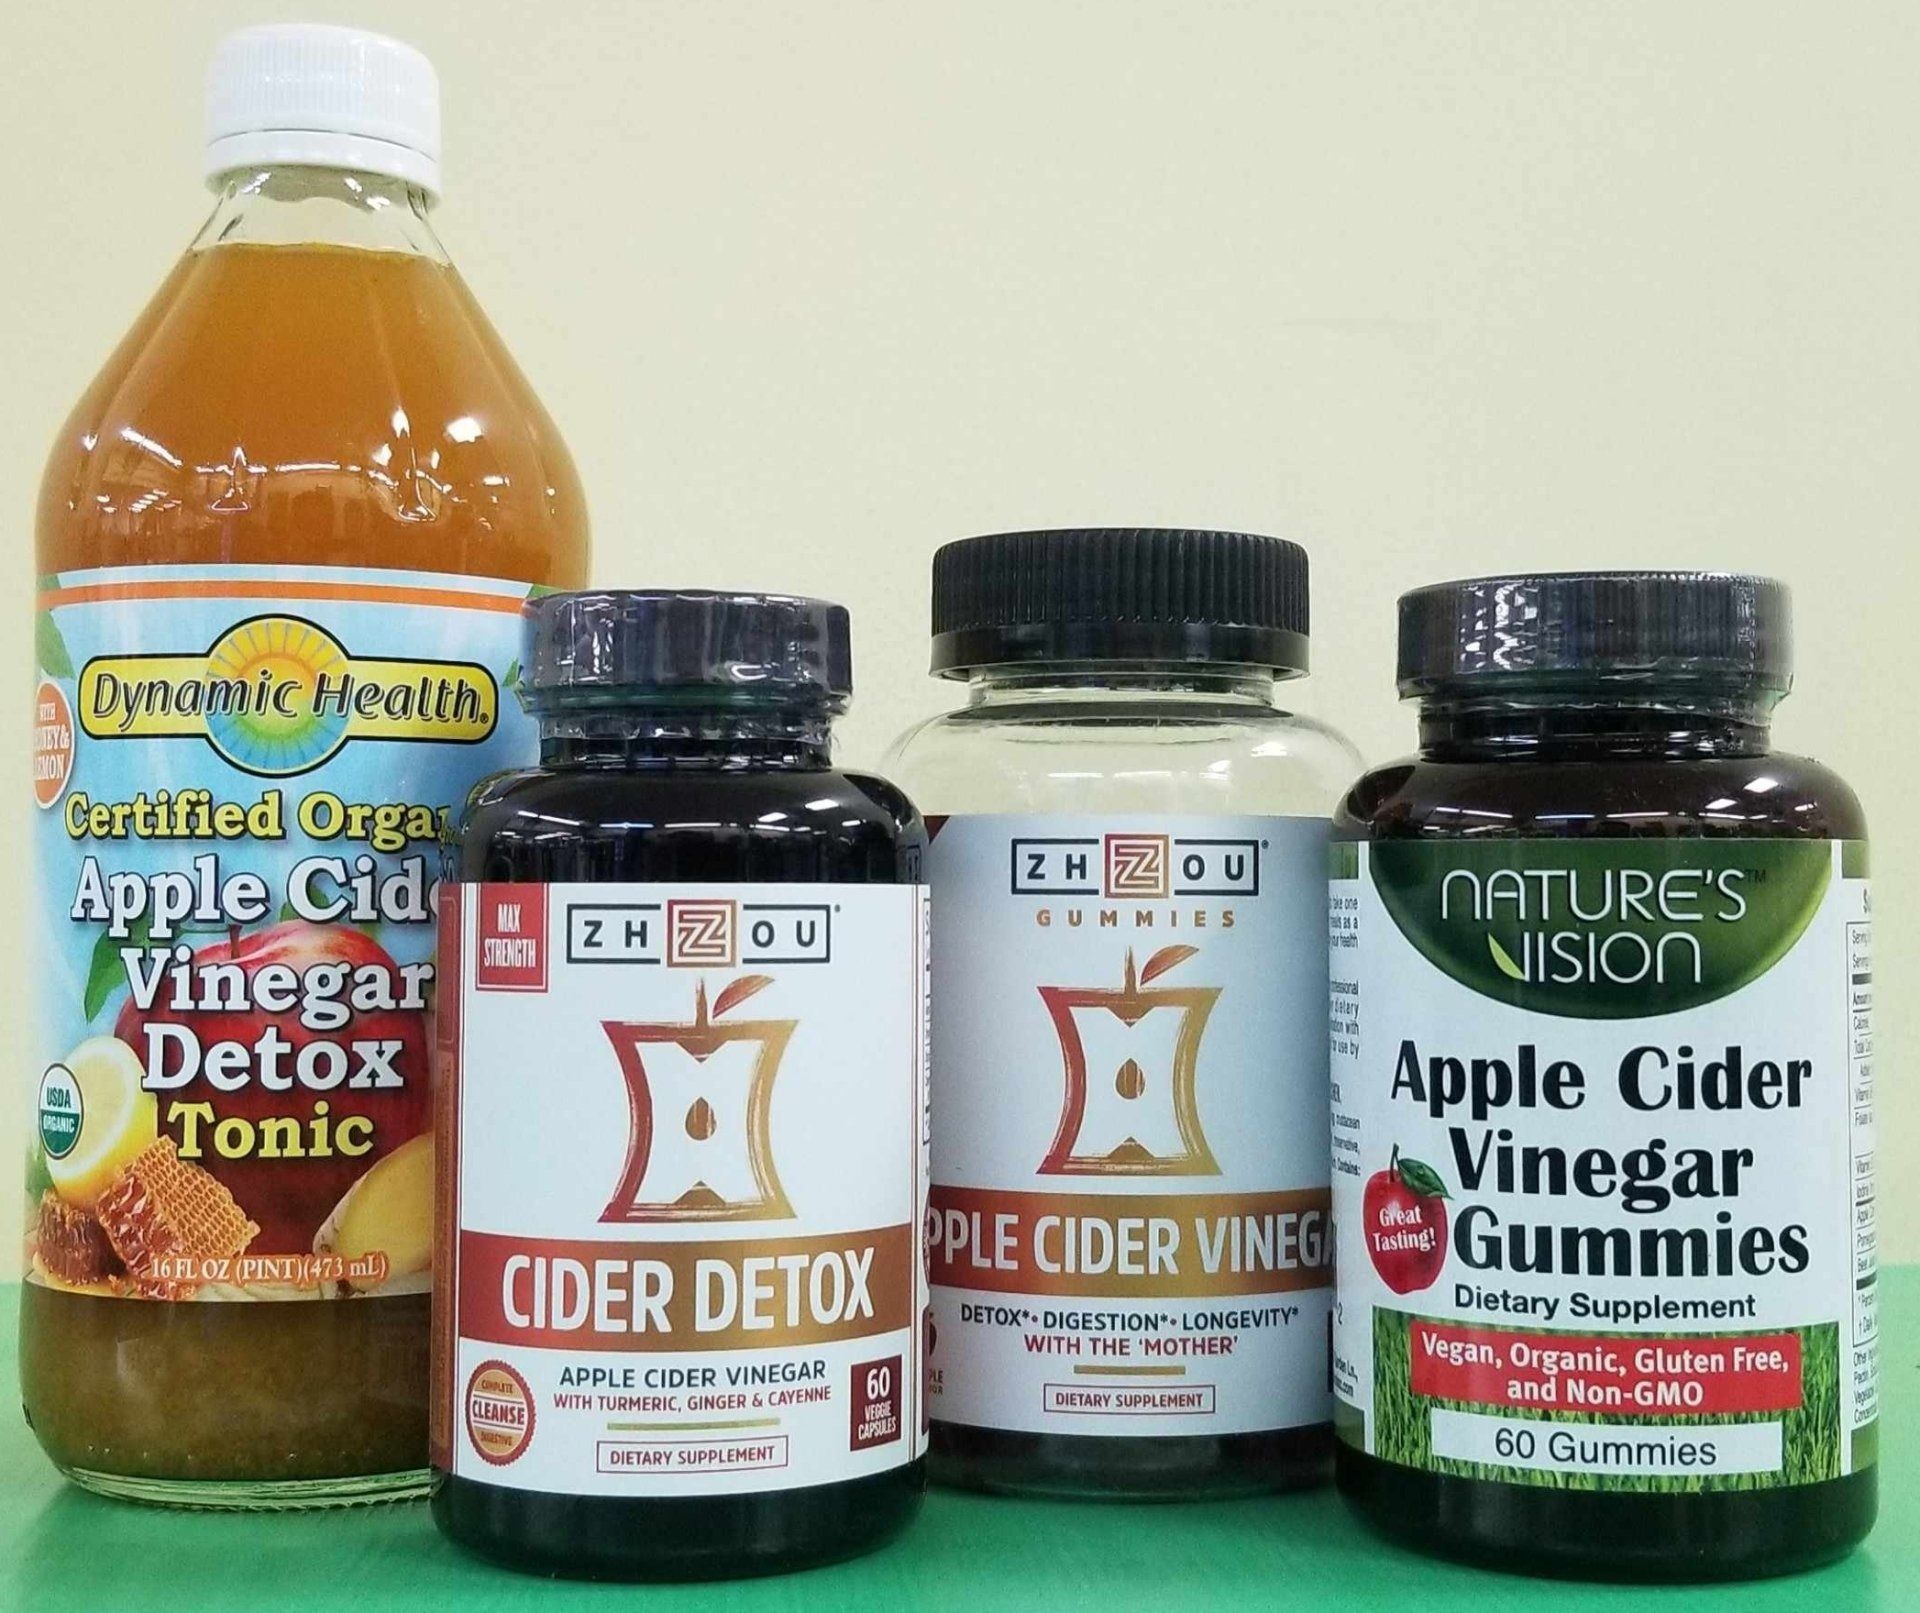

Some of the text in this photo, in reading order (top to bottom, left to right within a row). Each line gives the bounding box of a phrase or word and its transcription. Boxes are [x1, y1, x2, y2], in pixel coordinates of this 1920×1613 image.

[93, 669, 302, 732] Dynamic
[65, 789, 283, 840] Certified
[70, 853, 270, 940] Apple
[1440, 867, 1748, 922] NATURE'S
[498, 903, 521, 933] MAX
[1035, 909, 1236, 928] GUMMIES
[484, 938, 537, 968] STRENGTH
[119, 945, 436, 1031] Vinegar
[140, 1021, 404, 1091] Detox
[1391, 1039, 1813, 1122] Apple Cider
[47, 1086, 71, 1109] USDA
[43, 1114, 75, 1133] ORGANIC
[167, 1101, 375, 1159] Tonic
[1447, 1126, 1754, 1215] Vinegar
[1379, 1207, 1423, 1227] Great
[1033, 1215, 1181, 1276] CIDER
[1371, 1230, 1436, 1253] Tasting!
[1452, 1204, 1811, 1278] Gummies
[152, 1257, 171, 1279] 16
[175, 1257, 198, 1279] FL
[201, 1258, 230, 1280] OZ
[350, 1250, 387, 1280] mL)
[503, 1247, 875, 1334] CIDER DETOX
[1454, 1283, 1757, 1324] Dietary Supplement
[1024, 1335, 1081, 1354] WITH
[1088, 1337, 1131, 1356] THE
[1421, 1331, 1789, 1376] Vegan, Organic, Gluten Free,
[559, 1360, 826, 1389] APPLE CIDER VINEGAR
[867, 1366, 890, 1400] 60
[553, 1386, 832, 1413] WITH TURMERIC, GINGER & CAYENNE
[1055, 1392, 1203, 1408] DIETARY SUPPLEMENT
[1507, 1376, 1704, 1407] and Non-GMO
[472, 1400, 525, 1426] CLEANSE
[864, 1400, 892, 1422] VEGGIE
[858, 1416, 897, 1440] CAPSULES
[610, 1446, 776, 1466] DIETARY SUPPLEMENT
[1494, 1429, 1718, 1466] 60 Gummies
